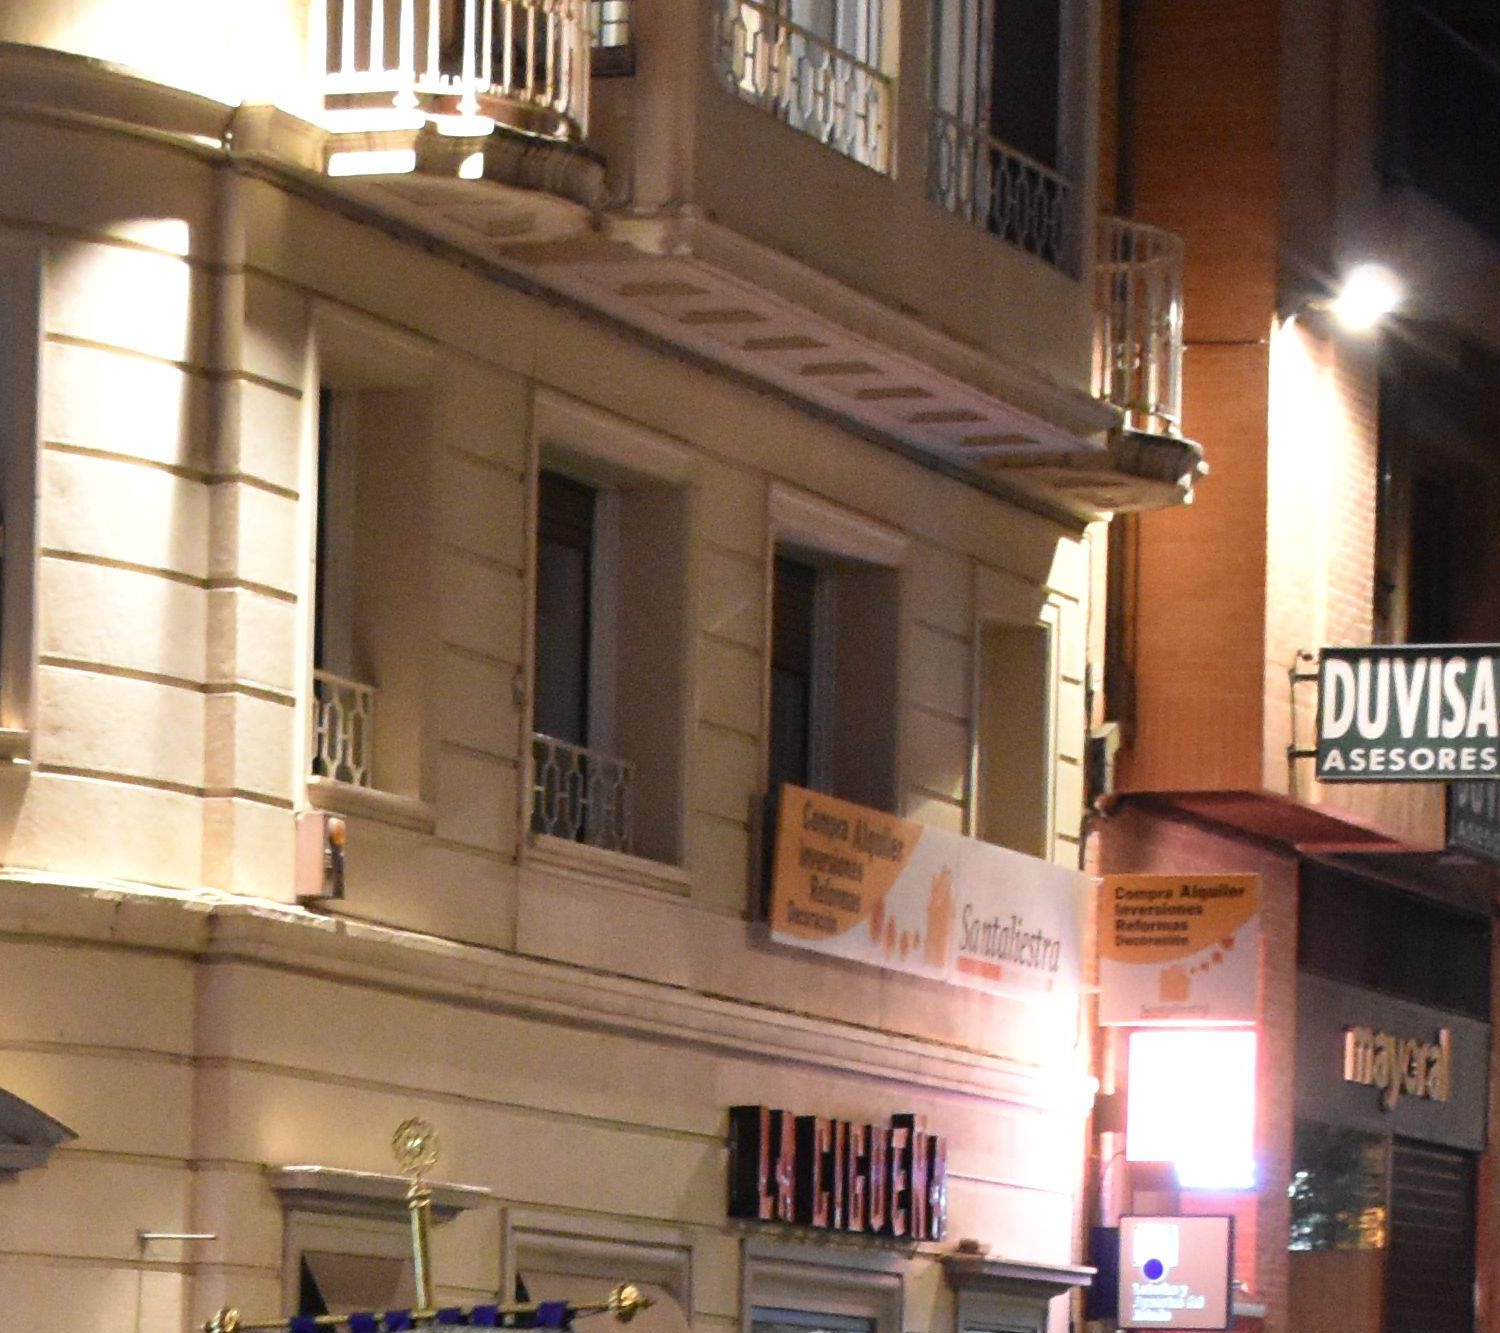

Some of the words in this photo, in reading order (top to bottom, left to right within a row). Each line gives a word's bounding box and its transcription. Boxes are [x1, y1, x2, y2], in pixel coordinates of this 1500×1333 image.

[1321, 656, 1499, 740] DUVISA
[1322, 747, 1498, 772] ASESORES
[1115, 886, 1173, 900] Compra
[1180, 883, 1245, 900] Alquiler
[1115, 903, 1203, 916] Inversiones
[1115, 918, 1189, 931] Reformas
[1344, 1027, 1453, 1112] mayoral
